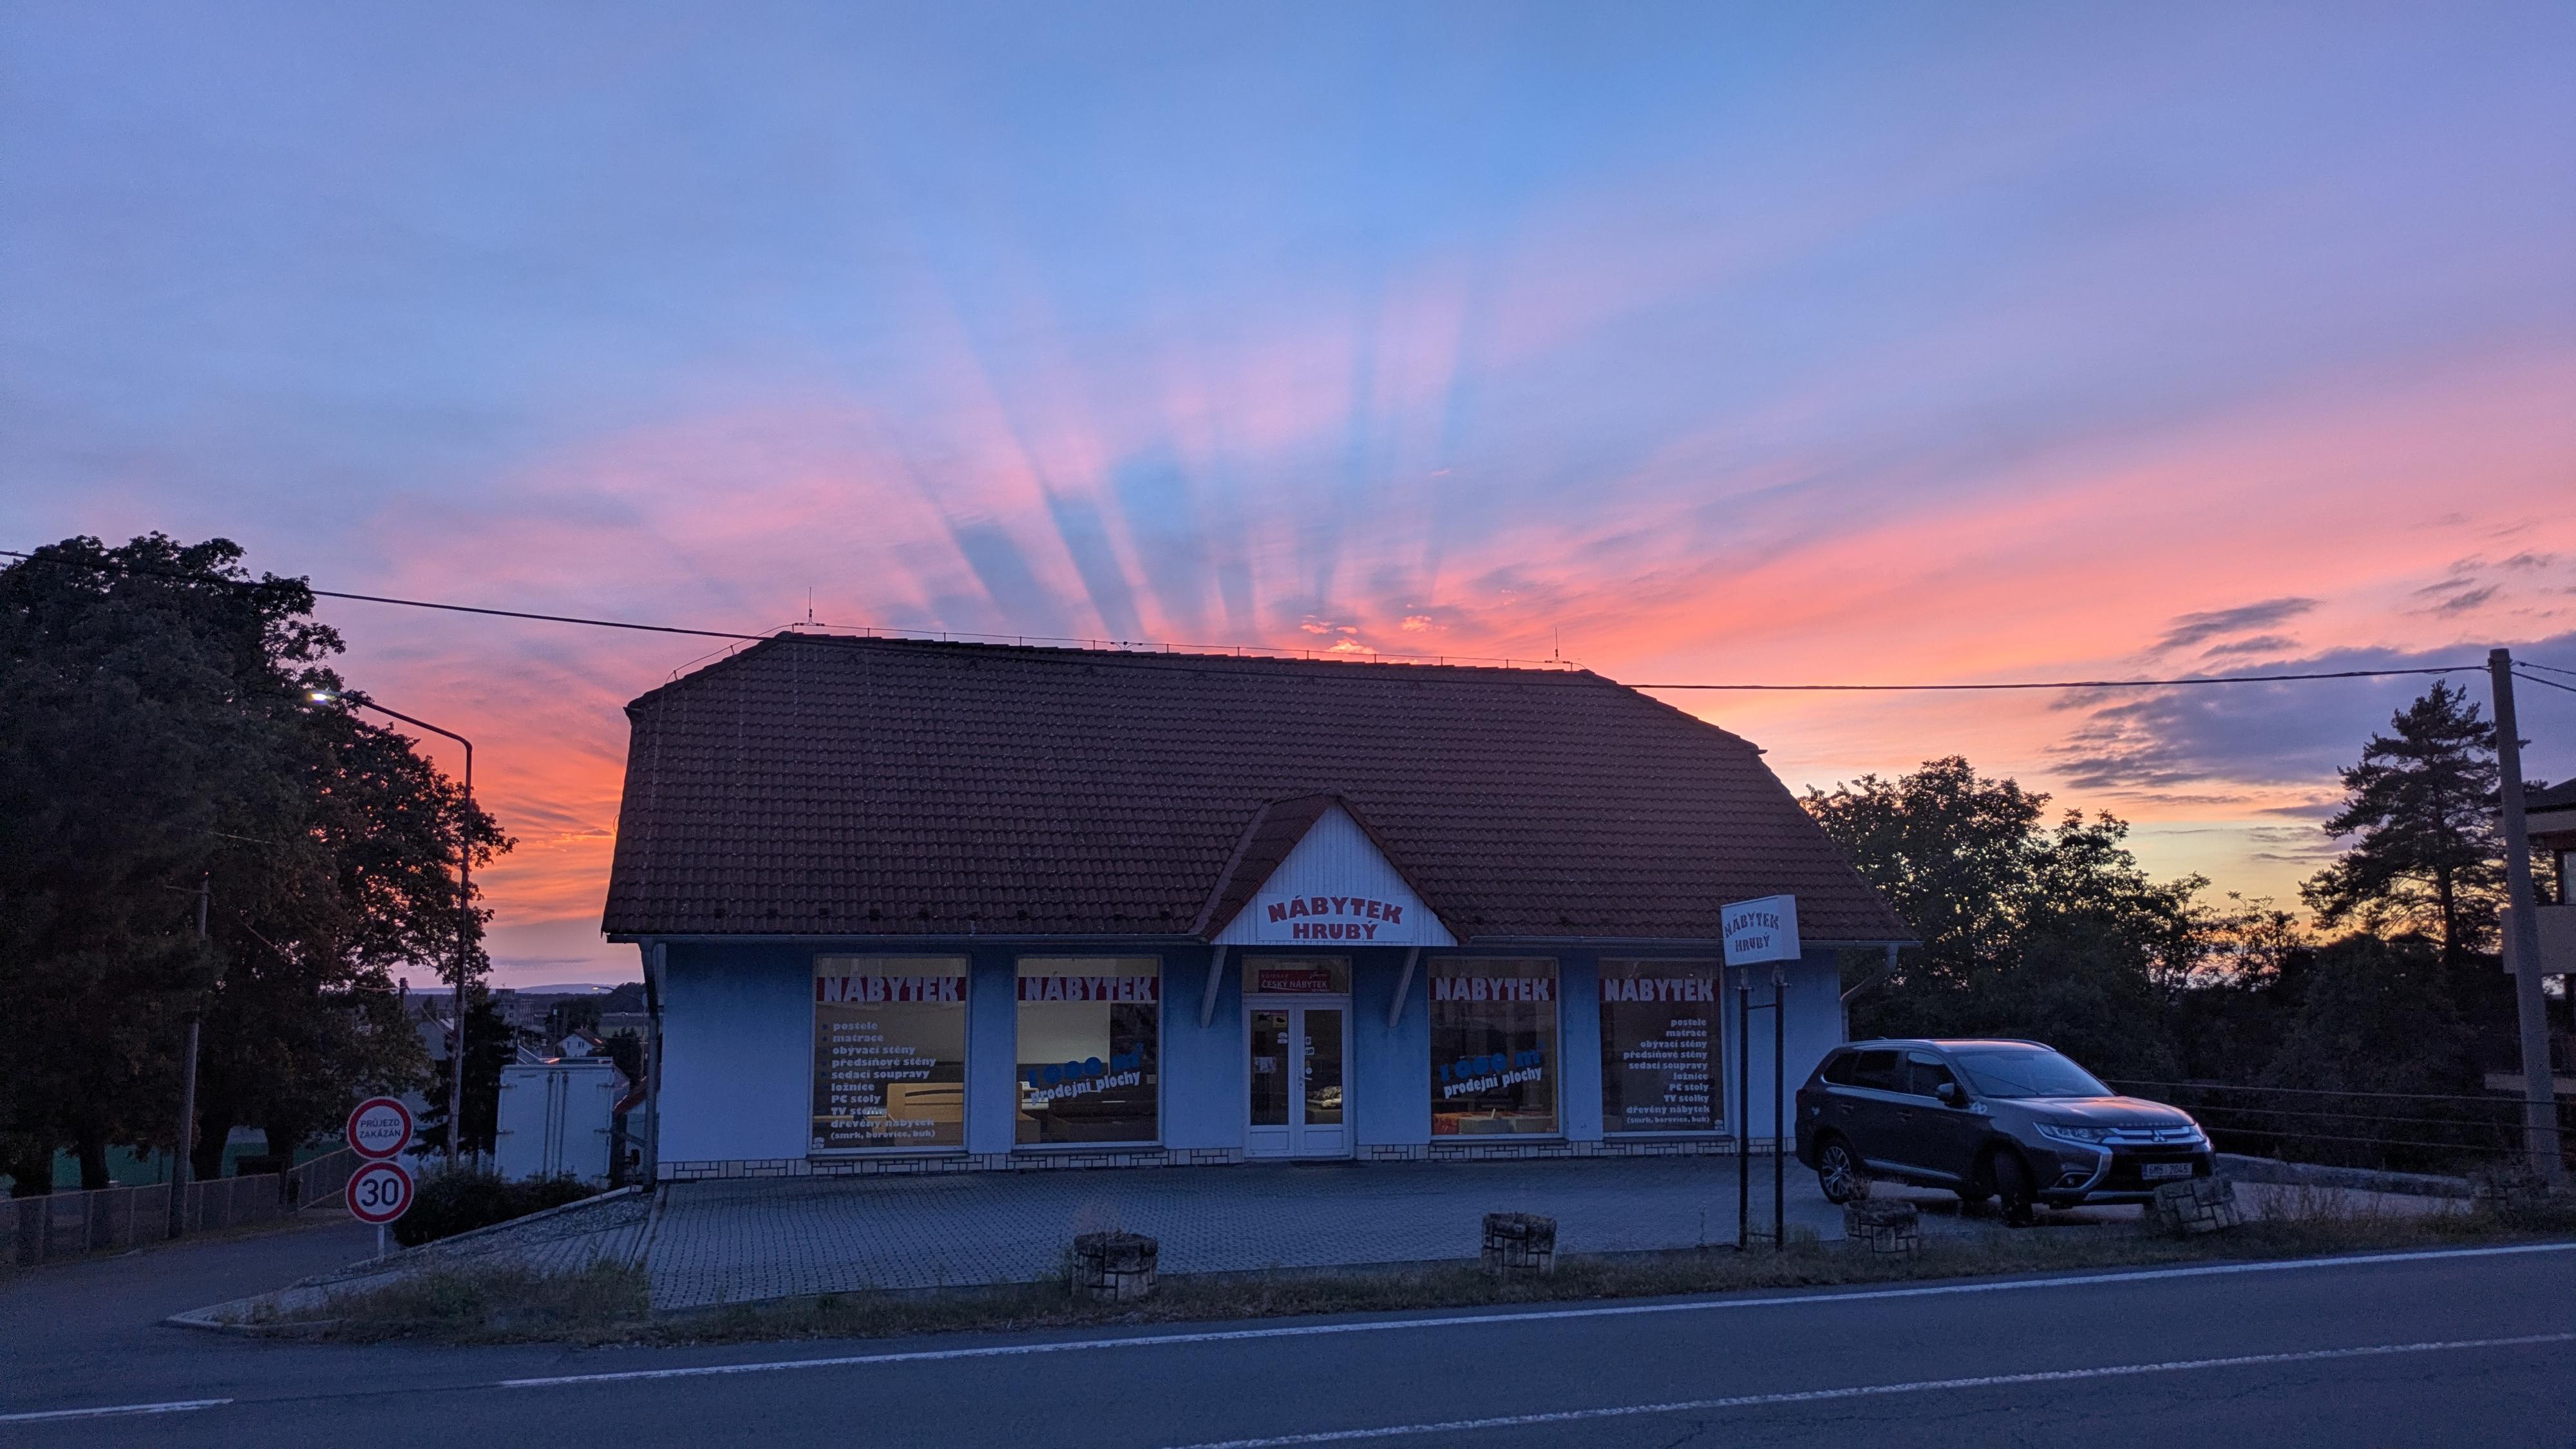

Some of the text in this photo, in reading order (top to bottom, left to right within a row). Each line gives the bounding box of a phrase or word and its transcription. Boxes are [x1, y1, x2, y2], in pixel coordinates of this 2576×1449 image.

[1267, 895, 1403, 924] NÁBYTEK
[1293, 920, 1378, 939] HRUBÝ
[1724, 912, 1779, 938] NÁBYTEK
[1735, 932, 1770, 952] HRUBÝ
[833, 1022, 878, 1031] postele
[832, 1046, 916, 1056] obývací stěny
[1680, 1051, 1708, 1059] stěny
[903, 1058, 936, 1067] stěny
[1663, 1063, 1708, 1071] soupravy
[831, 1070, 930, 1080] sedací soupravy
[831, 1083, 875, 1091] ložnice
[1443, 1068, 1542, 1099] prodejní plochy
[1684, 1083, 1709, 1092] stoly
[1030, 1071, 1141, 1106] prodejní plochy
[831, 1095, 881, 1104] PC stoly
[1678, 1095, 1710, 1103] stolky
[831, 1107, 846, 1115] TV
[1669, 1105, 1710, 1114] nábytek
[361, 1117, 400, 1128] PRŮJEZD
[359, 1128, 401, 1139] ZAKÁZÁN
[830, 1131, 864, 1140] (smrk,
[361, 1177, 399, 1207] 30
